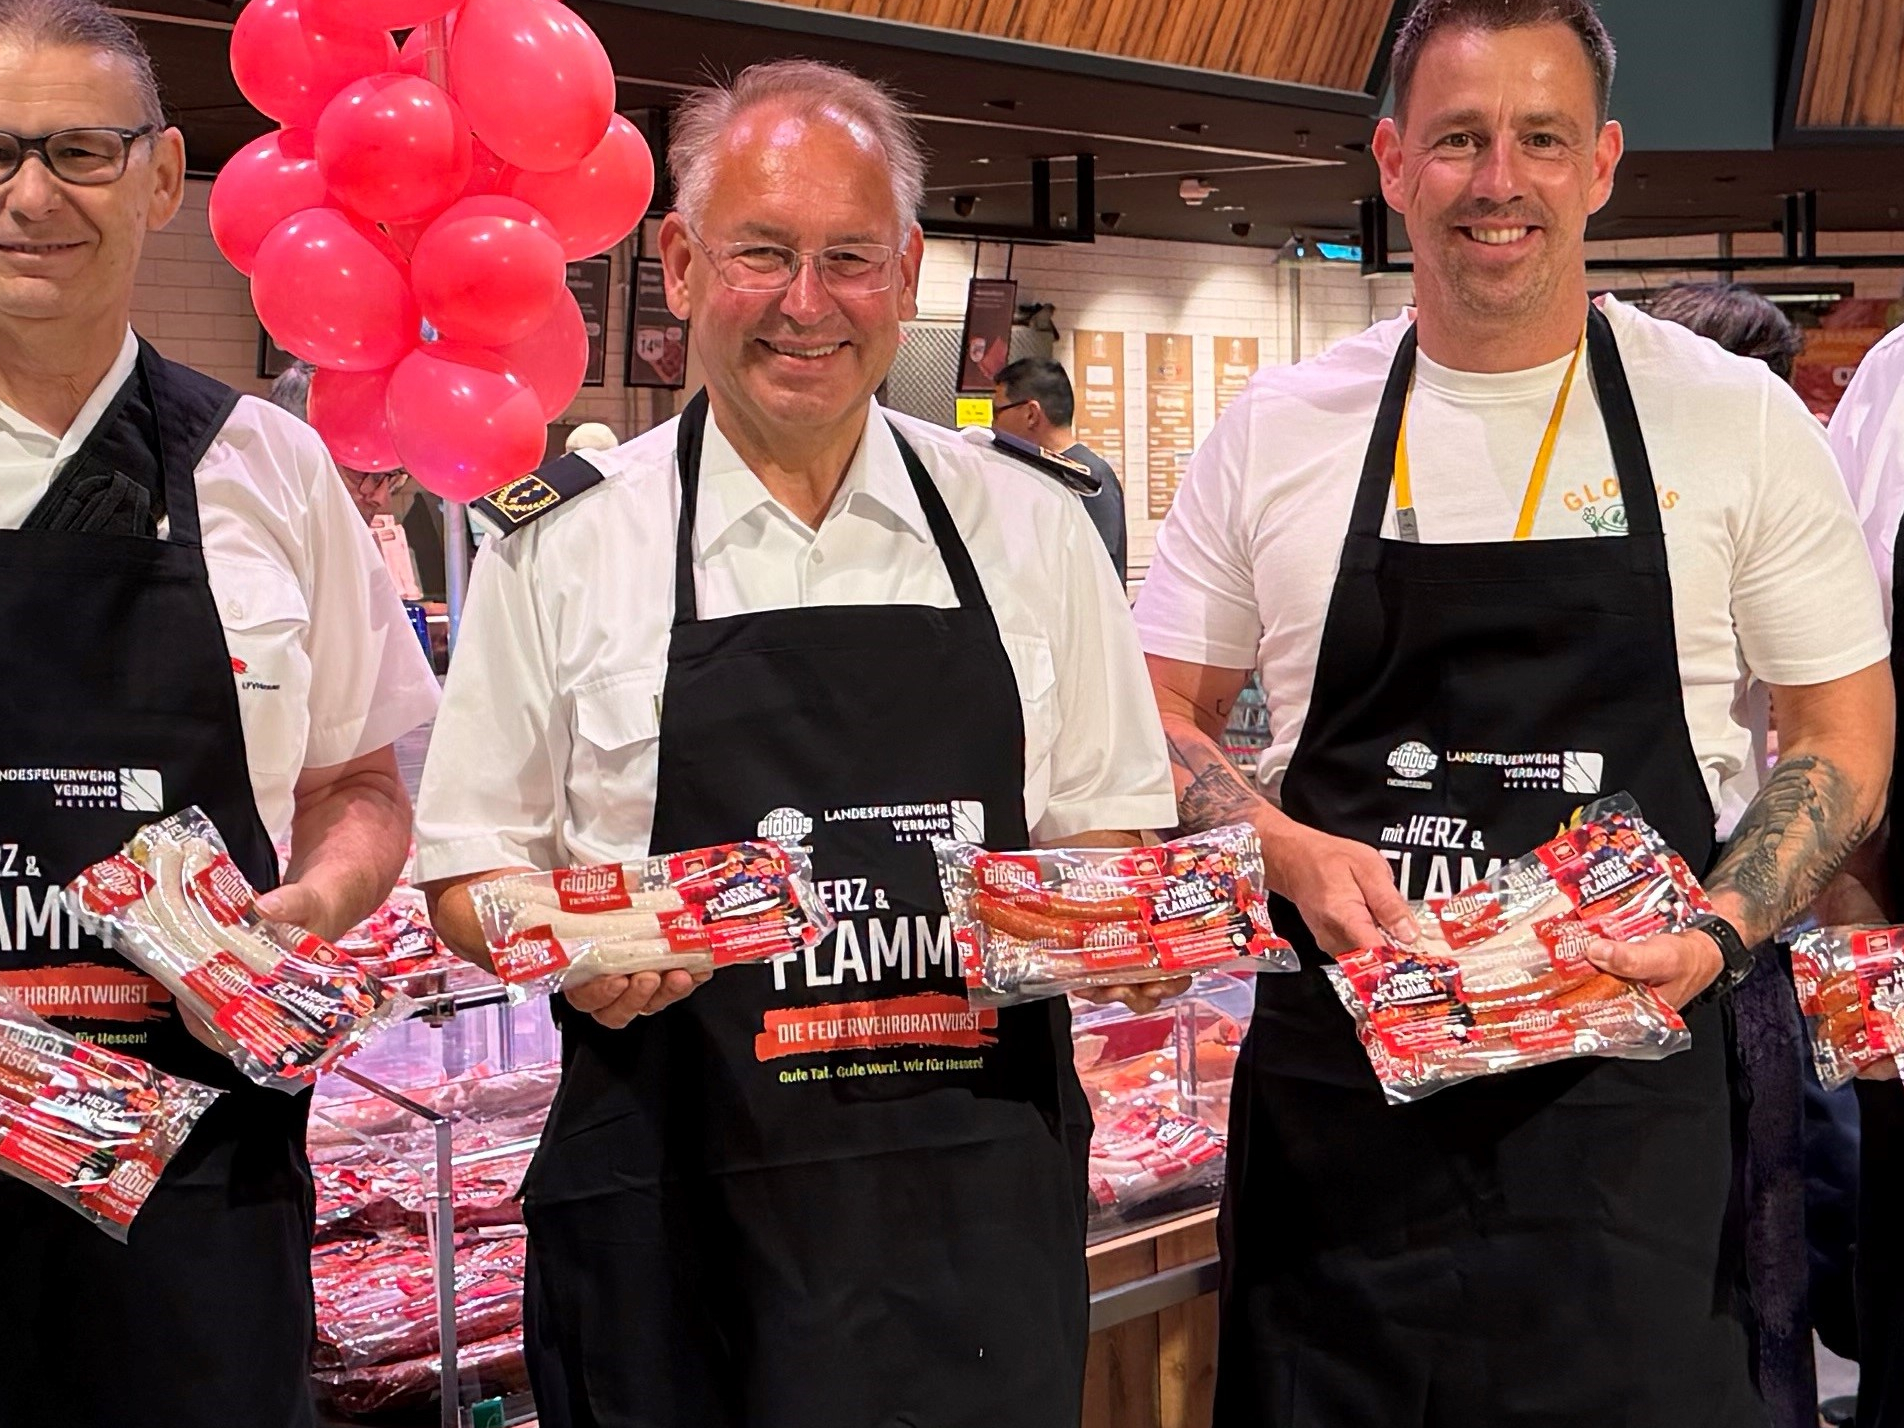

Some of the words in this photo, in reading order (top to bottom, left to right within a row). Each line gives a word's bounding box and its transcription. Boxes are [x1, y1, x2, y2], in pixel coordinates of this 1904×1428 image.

[1447, 751, 1559, 766] LANDESFEUERWEHR
[1504, 768, 1560, 779] VERBAND
[54, 784, 116, 797] VERBAND
[824, 804, 948, 822] LANDESFEUERWEHR
[893, 819, 950, 831] VERBAND
[1381, 823, 1405, 842] mit
[1406, 815, 1467, 849] HERZ
[1471, 831, 1484, 850] &
[26, 856, 40, 877] &
[1592, 856, 1624, 876] HERZ
[1580, 868, 1630, 898] FLAMME
[875, 889, 889, 910] &
[778, 1023, 804, 1044] DIE
[808, 1011, 981, 1041] FEUERWEHRBRATWURST
[98, 1032, 147, 1044] Hessen!
